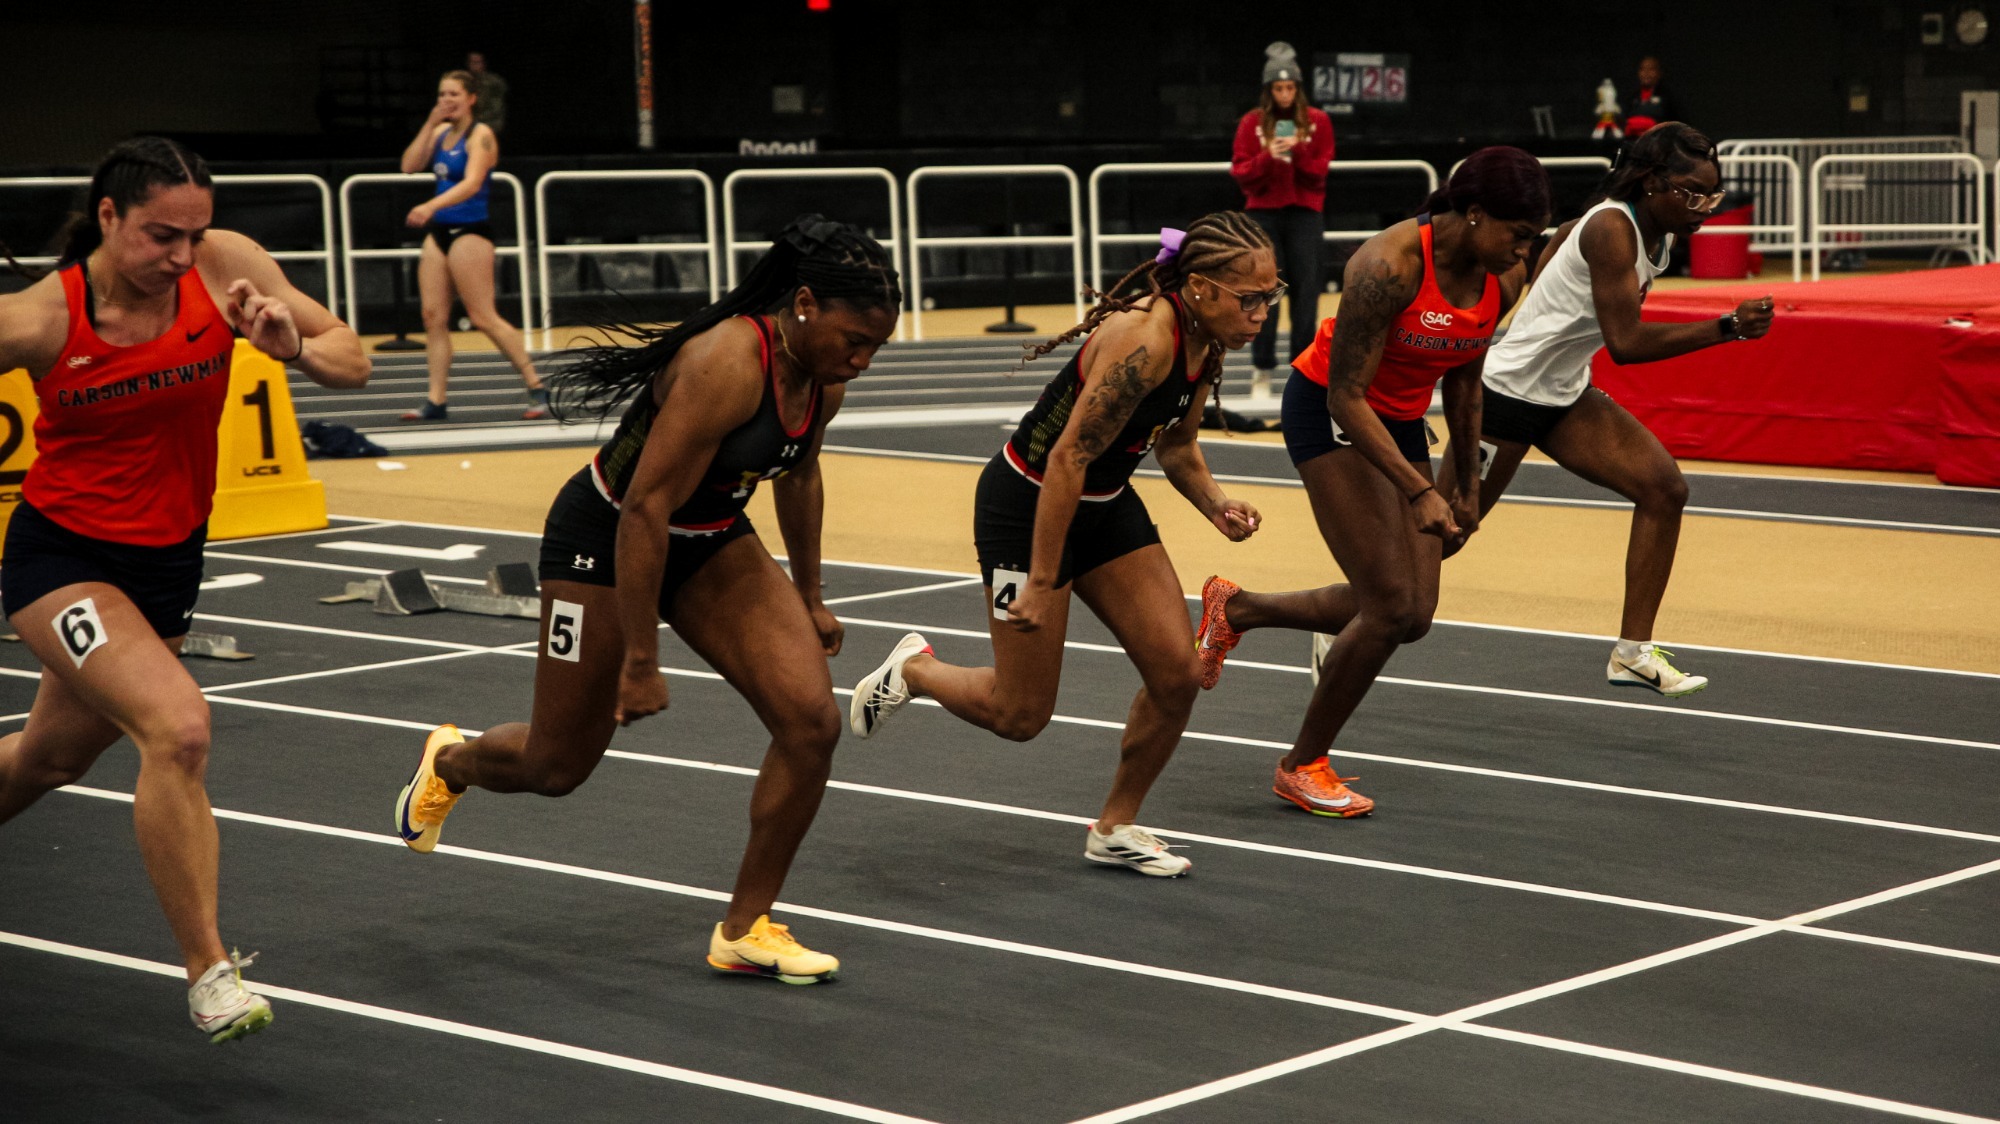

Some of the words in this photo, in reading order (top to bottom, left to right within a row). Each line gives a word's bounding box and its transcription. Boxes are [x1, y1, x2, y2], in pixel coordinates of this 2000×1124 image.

[1424, 311, 1453, 326] SAC
[57, 351, 227, 407] CARSON-NEWMAN
[242, 379, 275, 459] 1
[242, 465, 282, 477] UCS
[994, 582, 1017, 611] 4
[61, 606, 96, 657] 6
[550, 613, 575, 656] 5
